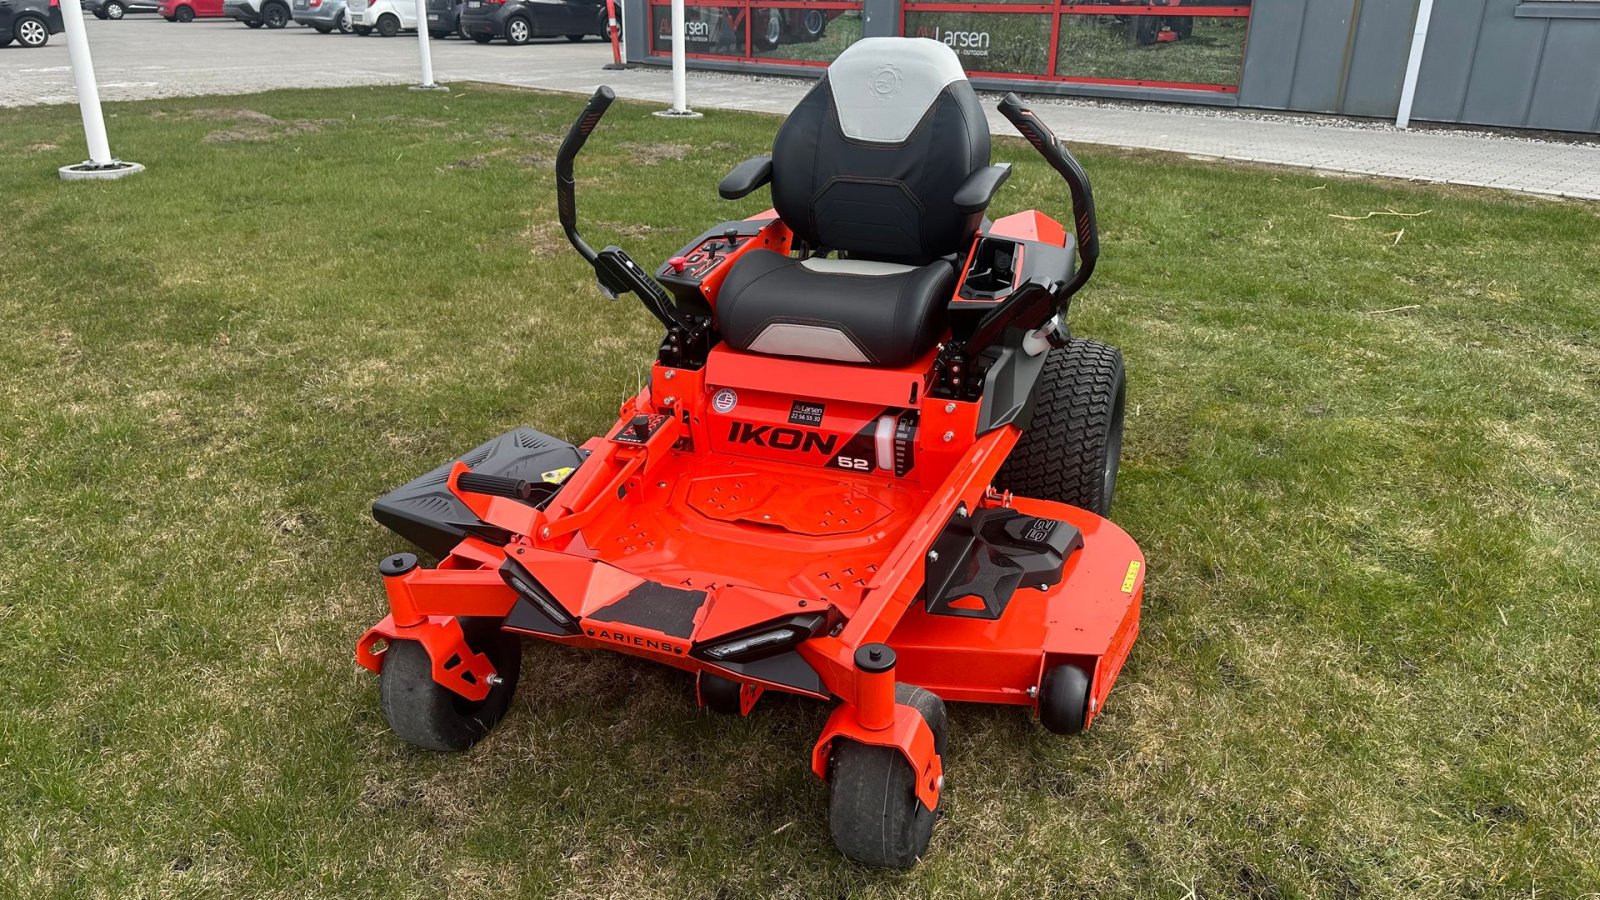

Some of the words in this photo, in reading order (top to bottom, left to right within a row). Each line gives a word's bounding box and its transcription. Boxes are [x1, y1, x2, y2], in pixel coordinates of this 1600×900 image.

[727, 421, 839, 456] IKON
[837, 456, 869, 471] 52
[1025, 518, 1056, 542] 52
[600, 630, 673, 652] ARIENS
